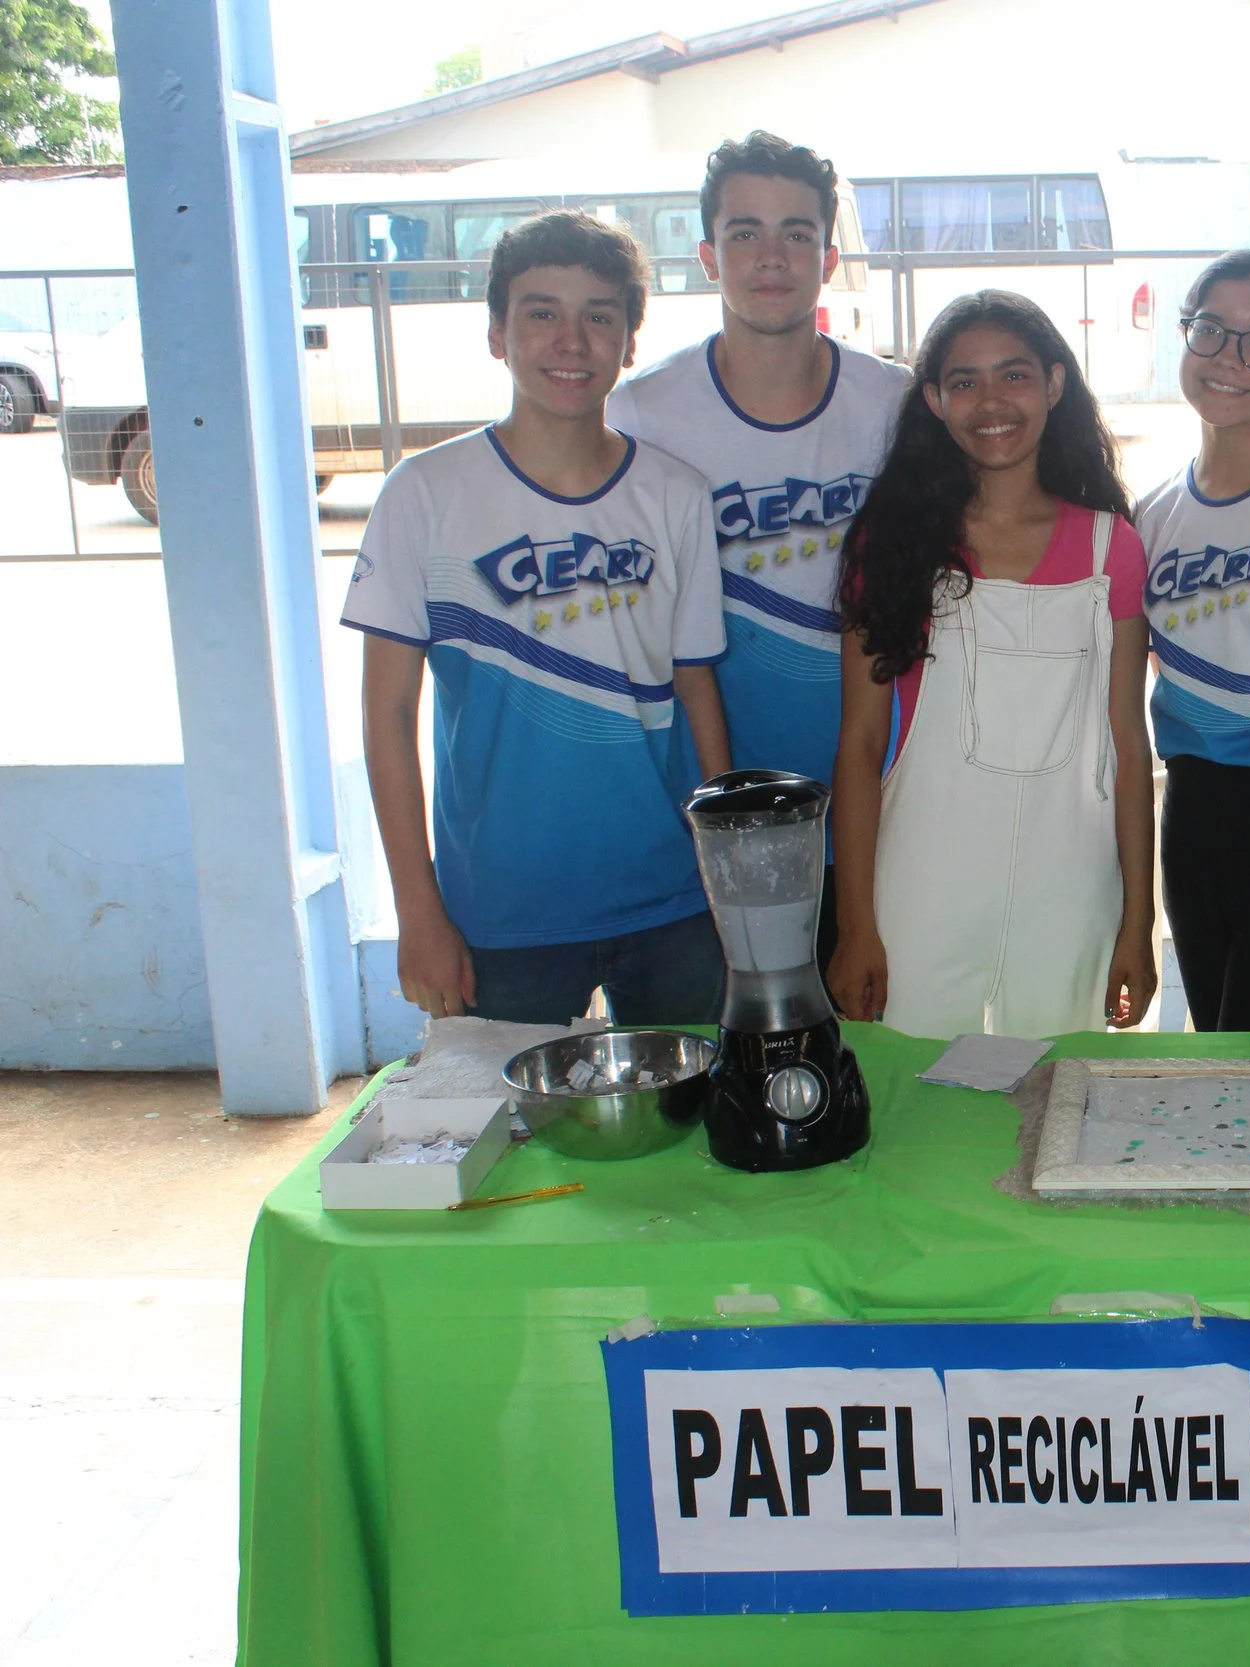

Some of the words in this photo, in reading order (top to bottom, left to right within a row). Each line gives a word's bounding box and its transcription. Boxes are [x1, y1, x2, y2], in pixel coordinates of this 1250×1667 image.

[496, 541, 656, 594] CEART
[672, 1406, 943, 1518] PAPEL
[967, 1395, 1240, 1505] RECICLÁVEL
